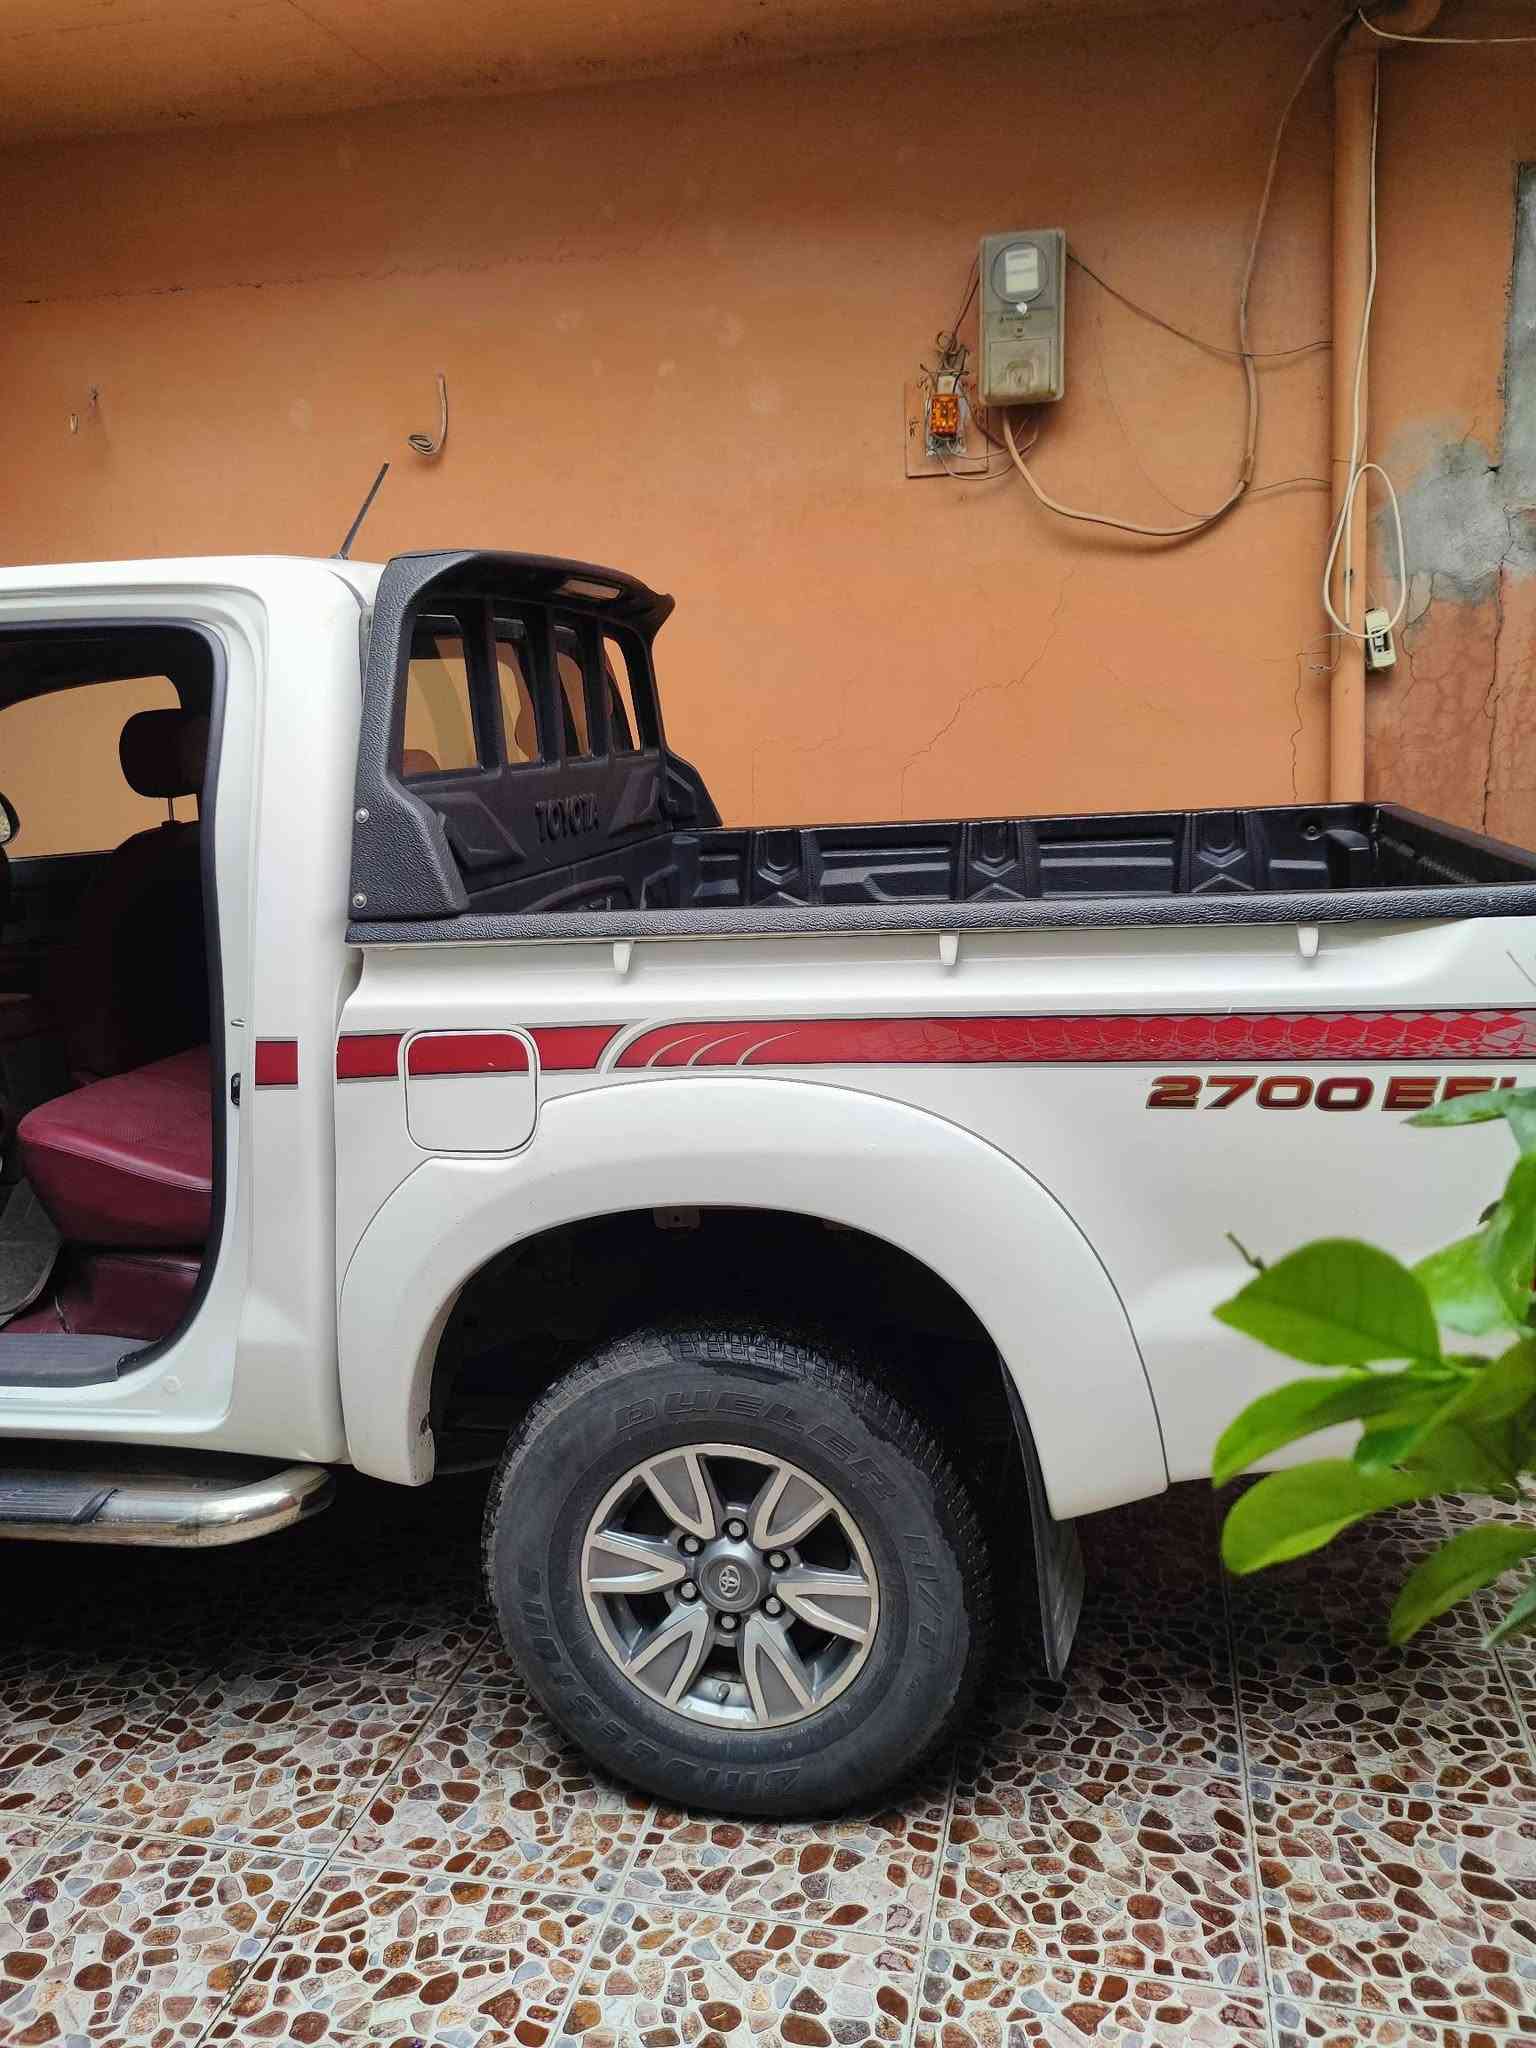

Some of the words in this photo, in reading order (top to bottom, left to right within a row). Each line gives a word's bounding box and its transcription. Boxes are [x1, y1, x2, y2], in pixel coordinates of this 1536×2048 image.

[535, 793, 600, 843] TOYOTA
[1145, 1075, 1375, 1111] 2700
[615, 1389, 898, 1501] DUELER
